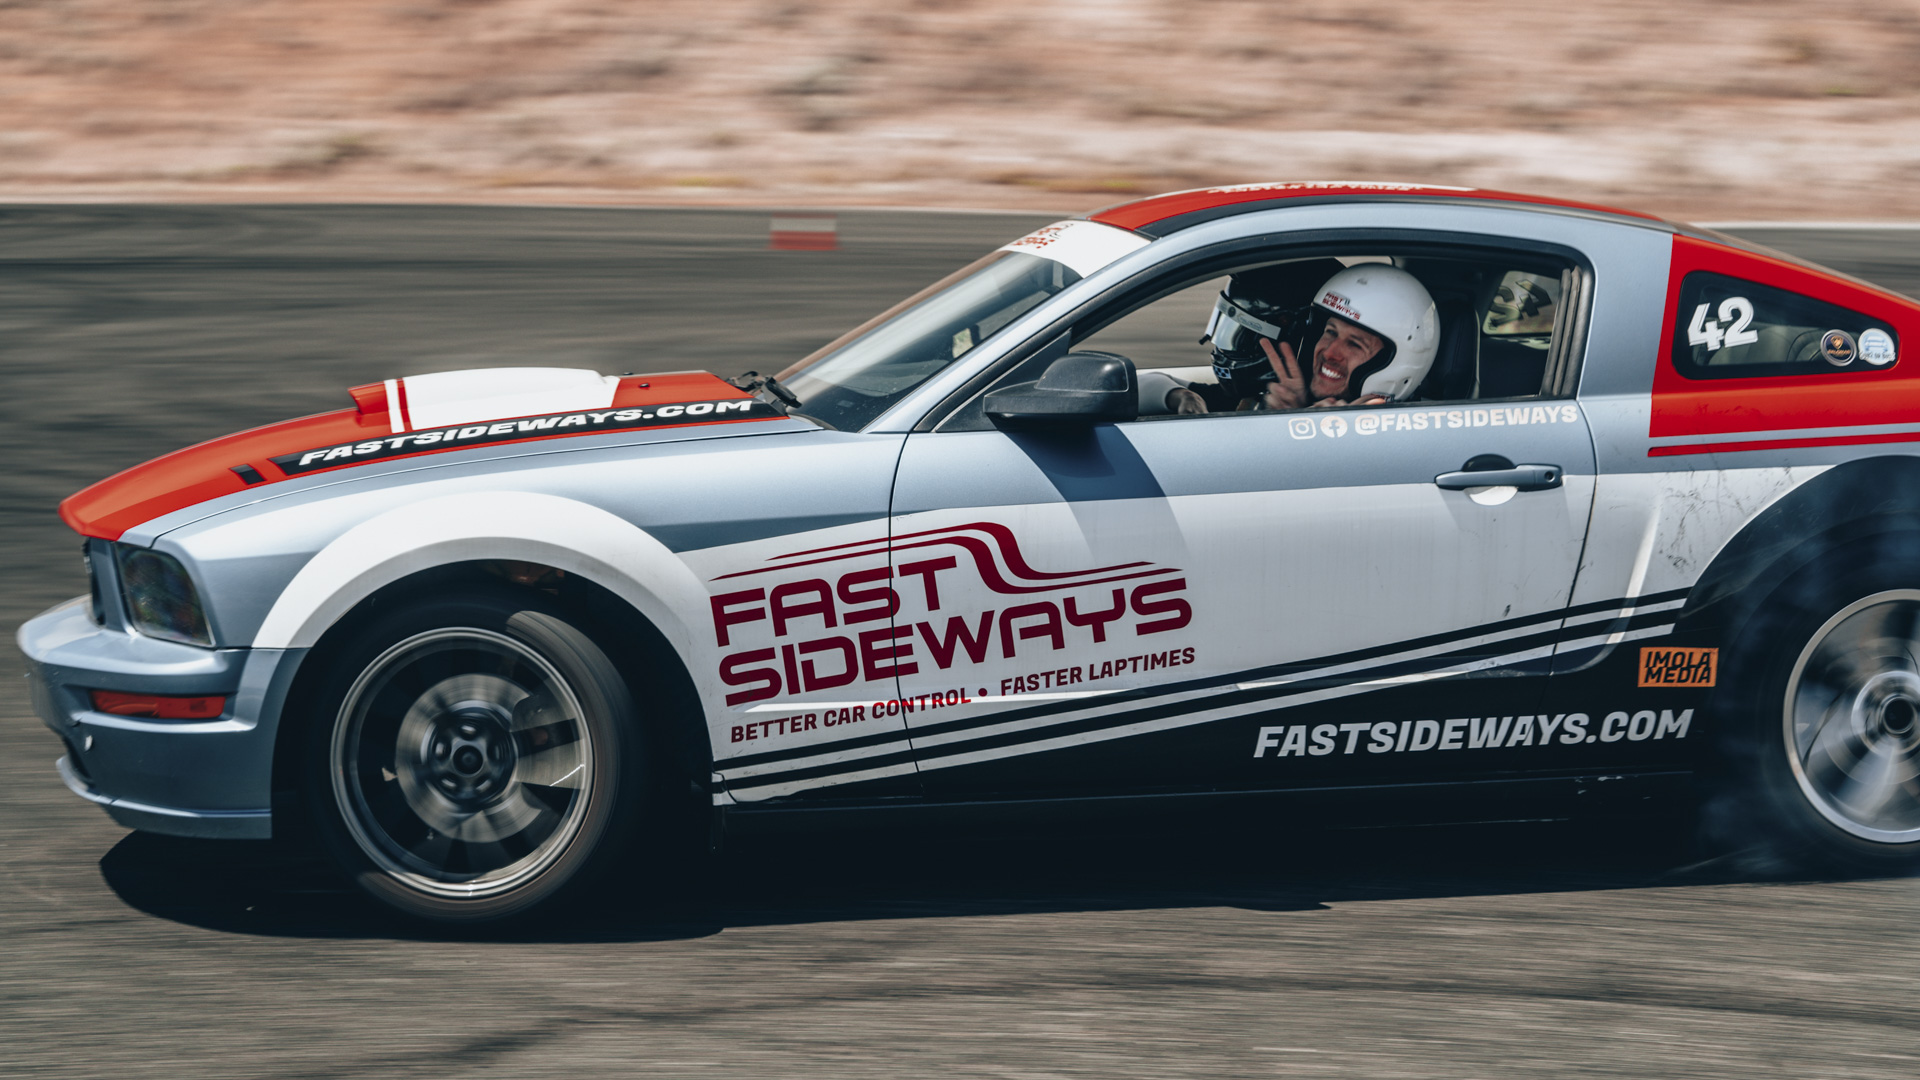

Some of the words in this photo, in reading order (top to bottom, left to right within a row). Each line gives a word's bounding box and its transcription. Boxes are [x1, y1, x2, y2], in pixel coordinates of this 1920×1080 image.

[1687, 296, 1759, 352] 42
[298, 400, 754, 467] FASTSIDEWAYS.COM
[1354, 405, 1578, 436] @FASTSIDEWAYS
[709, 555, 958, 648] FAST
[718, 577, 1193, 707] SIDEWAYS
[1644, 651, 1711, 669] IMOLA
[731, 713, 818, 744] BETTER
[823, 706, 866, 729] CAR
[871, 686, 972, 718] CONTROL
[1000, 666, 1083, 697] FASTER
[1088, 646, 1196, 681] LAPTIMES
[1643, 666, 1711, 684] MEDIA
[1253, 708, 1695, 759] FASTSIDEWAYS.COM
